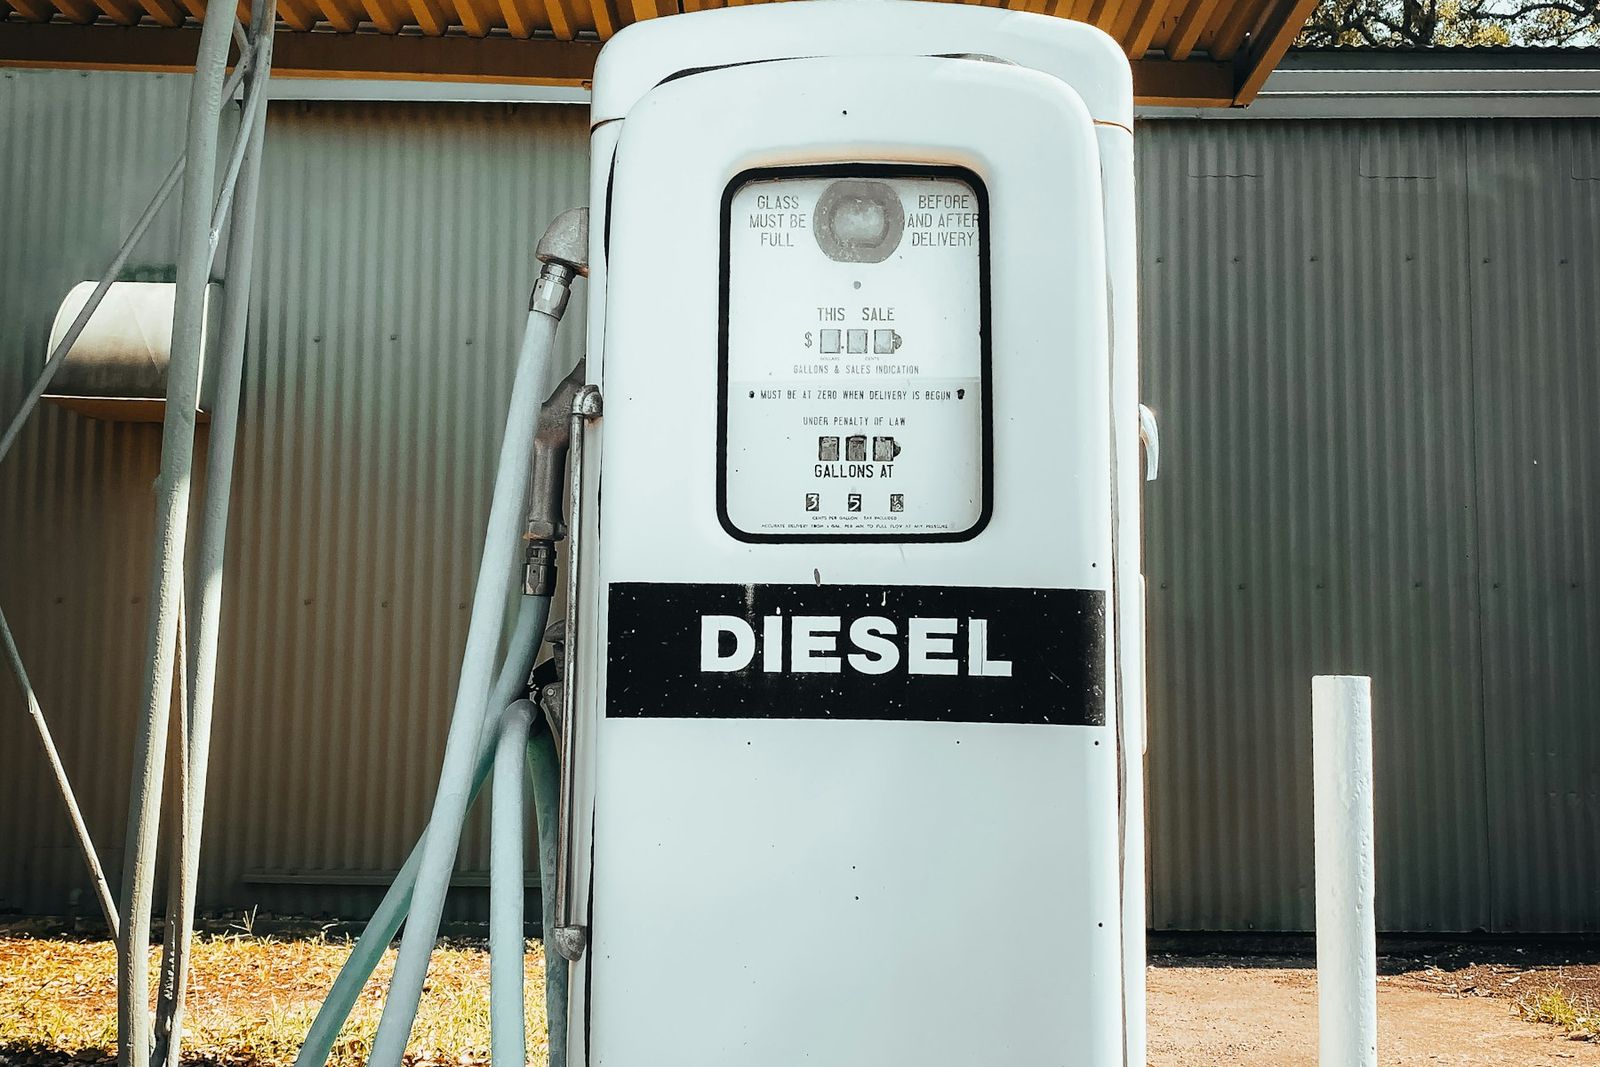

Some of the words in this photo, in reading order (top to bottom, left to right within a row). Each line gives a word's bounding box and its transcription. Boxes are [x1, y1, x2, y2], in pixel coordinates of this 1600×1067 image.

[757, 195, 800, 210] GLASS
[918, 194, 970, 209] BEFORE
[750, 213, 785, 229] MUST
[789, 213, 807, 229] BE
[907, 213, 933, 228] AND
[937, 213, 979, 228] AFTER
[761, 232, 794, 247] FULL
[912, 231, 975, 247] DELIVERY
[817, 307, 846, 321] THIS
[861, 307, 895, 321] SALE
[793, 364, 829, 375] GALLONS
[834, 364, 840, 375] &
[845, 365, 871, 375] SALES
[875, 364, 919, 375] INDICATION
[760, 389, 782, 400] MUST
[787, 389, 797, 400] BE
[802, 390, 812, 400] AT
[817, 390, 837, 400] ZERO
[842, 390, 864, 400] WHEN
[869, 390, 907, 400] DELIVERY
[912, 390, 920, 400] IS
[925, 390, 951, 401] BEGUN
[803, 416, 829, 426] UNDER
[833, 416, 869, 426] PENALTY
[873, 416, 884, 426] OF
[889, 417, 906, 427] LAW
[814, 464, 874, 479] GALLONS
[880, 464, 894, 479] AT
[700, 615, 1013, 677] DIESEL
